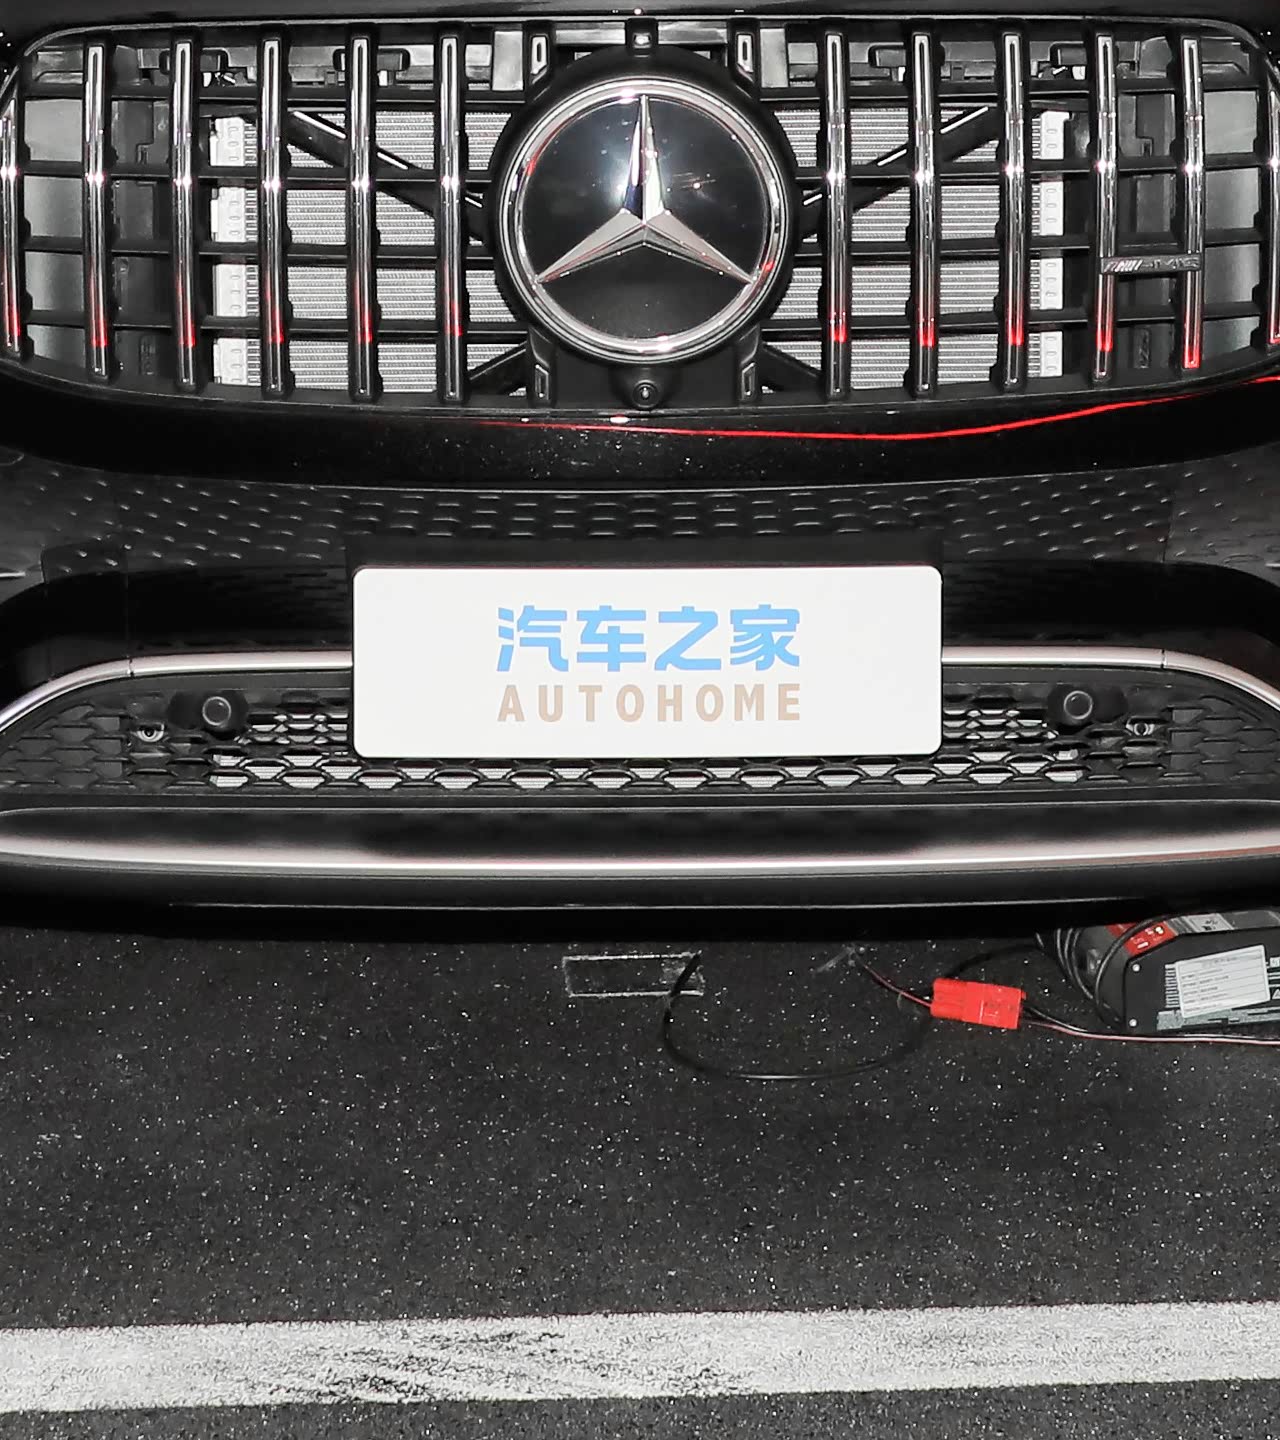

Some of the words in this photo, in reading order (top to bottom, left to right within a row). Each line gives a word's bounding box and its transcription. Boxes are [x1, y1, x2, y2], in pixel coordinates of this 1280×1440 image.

[496, 604, 801, 673] 汽车之家
[497, 683, 801, 722] AUTOHOME
